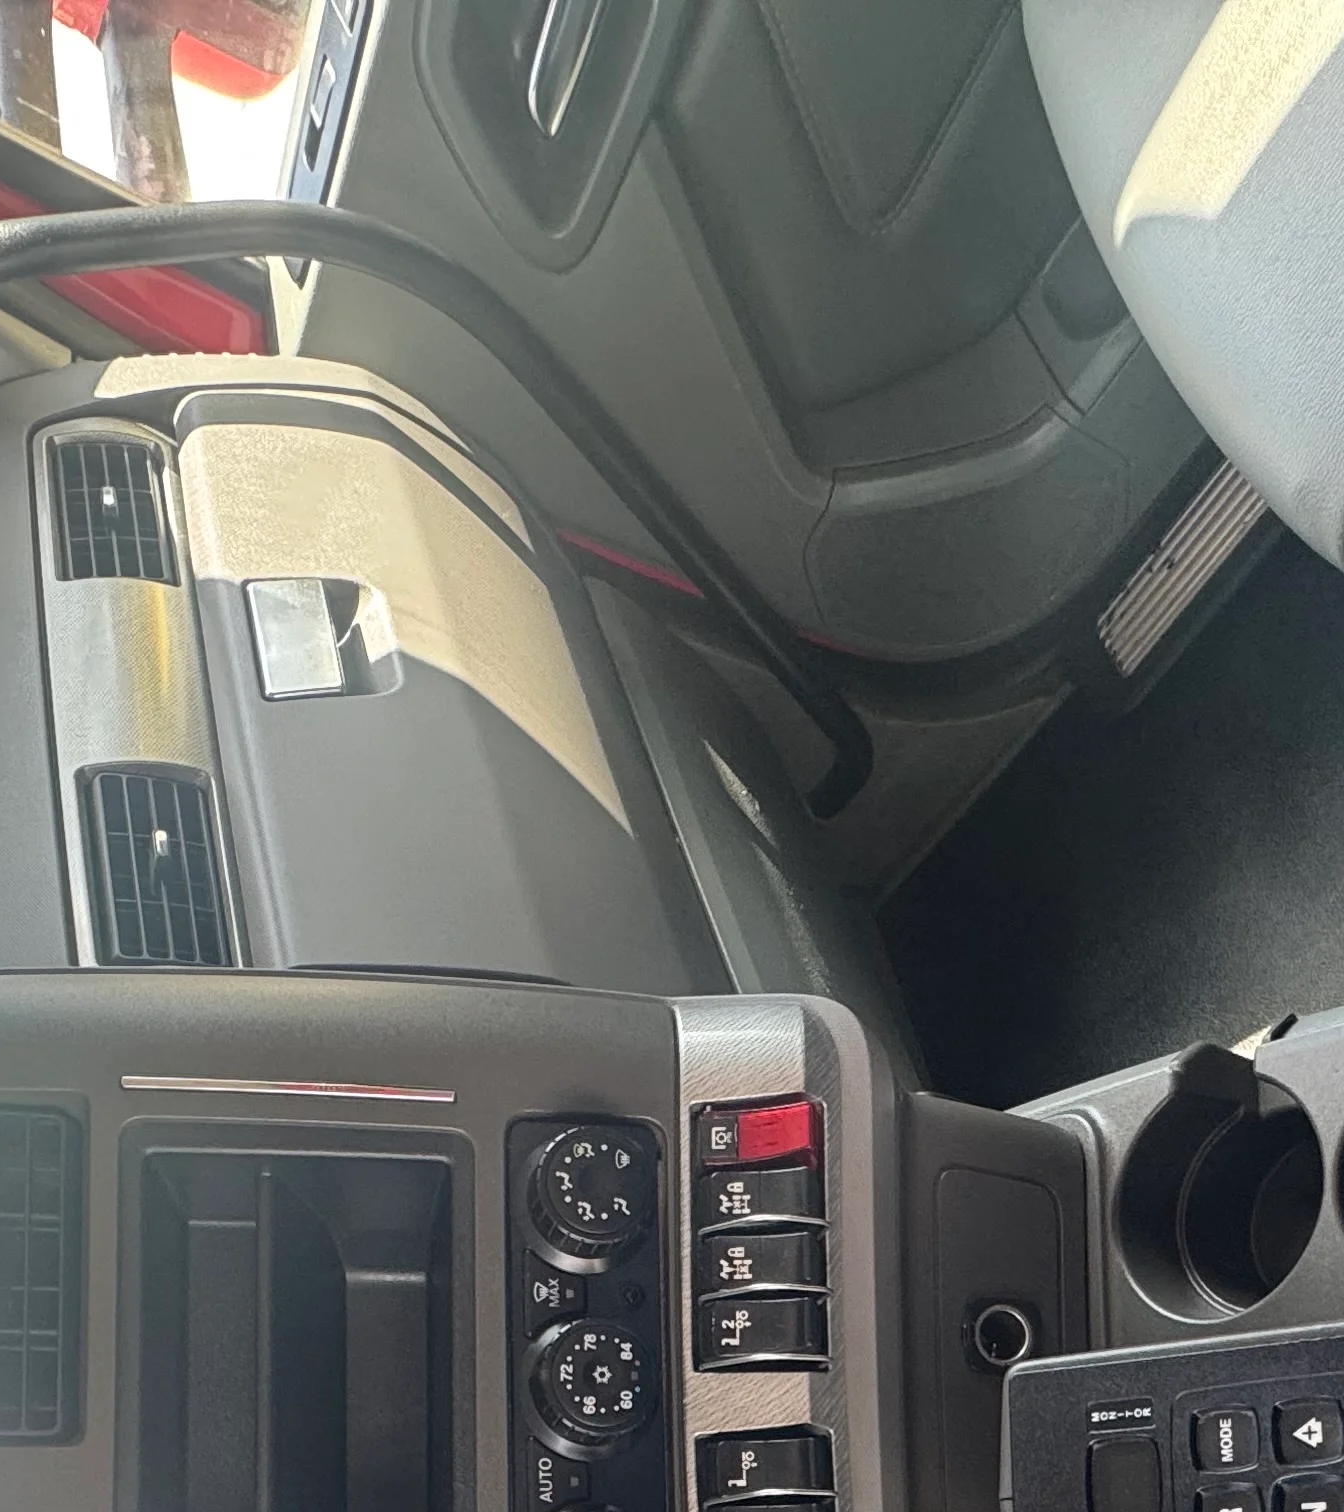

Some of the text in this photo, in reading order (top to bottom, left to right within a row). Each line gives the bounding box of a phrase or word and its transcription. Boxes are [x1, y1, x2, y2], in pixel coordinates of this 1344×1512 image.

[549, 1278, 560, 1307] MAX
[584, 1334, 596, 1351] 78
[621, 1342, 632, 1360] 84
[560, 1364, 573, 1382] 72
[583, 1396, 596, 1414] 66
[621, 1391, 632, 1409] 60
[1091, 1407, 1151, 1422] MONITOR
[1219, 1418, 1233, 1462] MODE
[538, 1457, 554, 1503] AUTO
